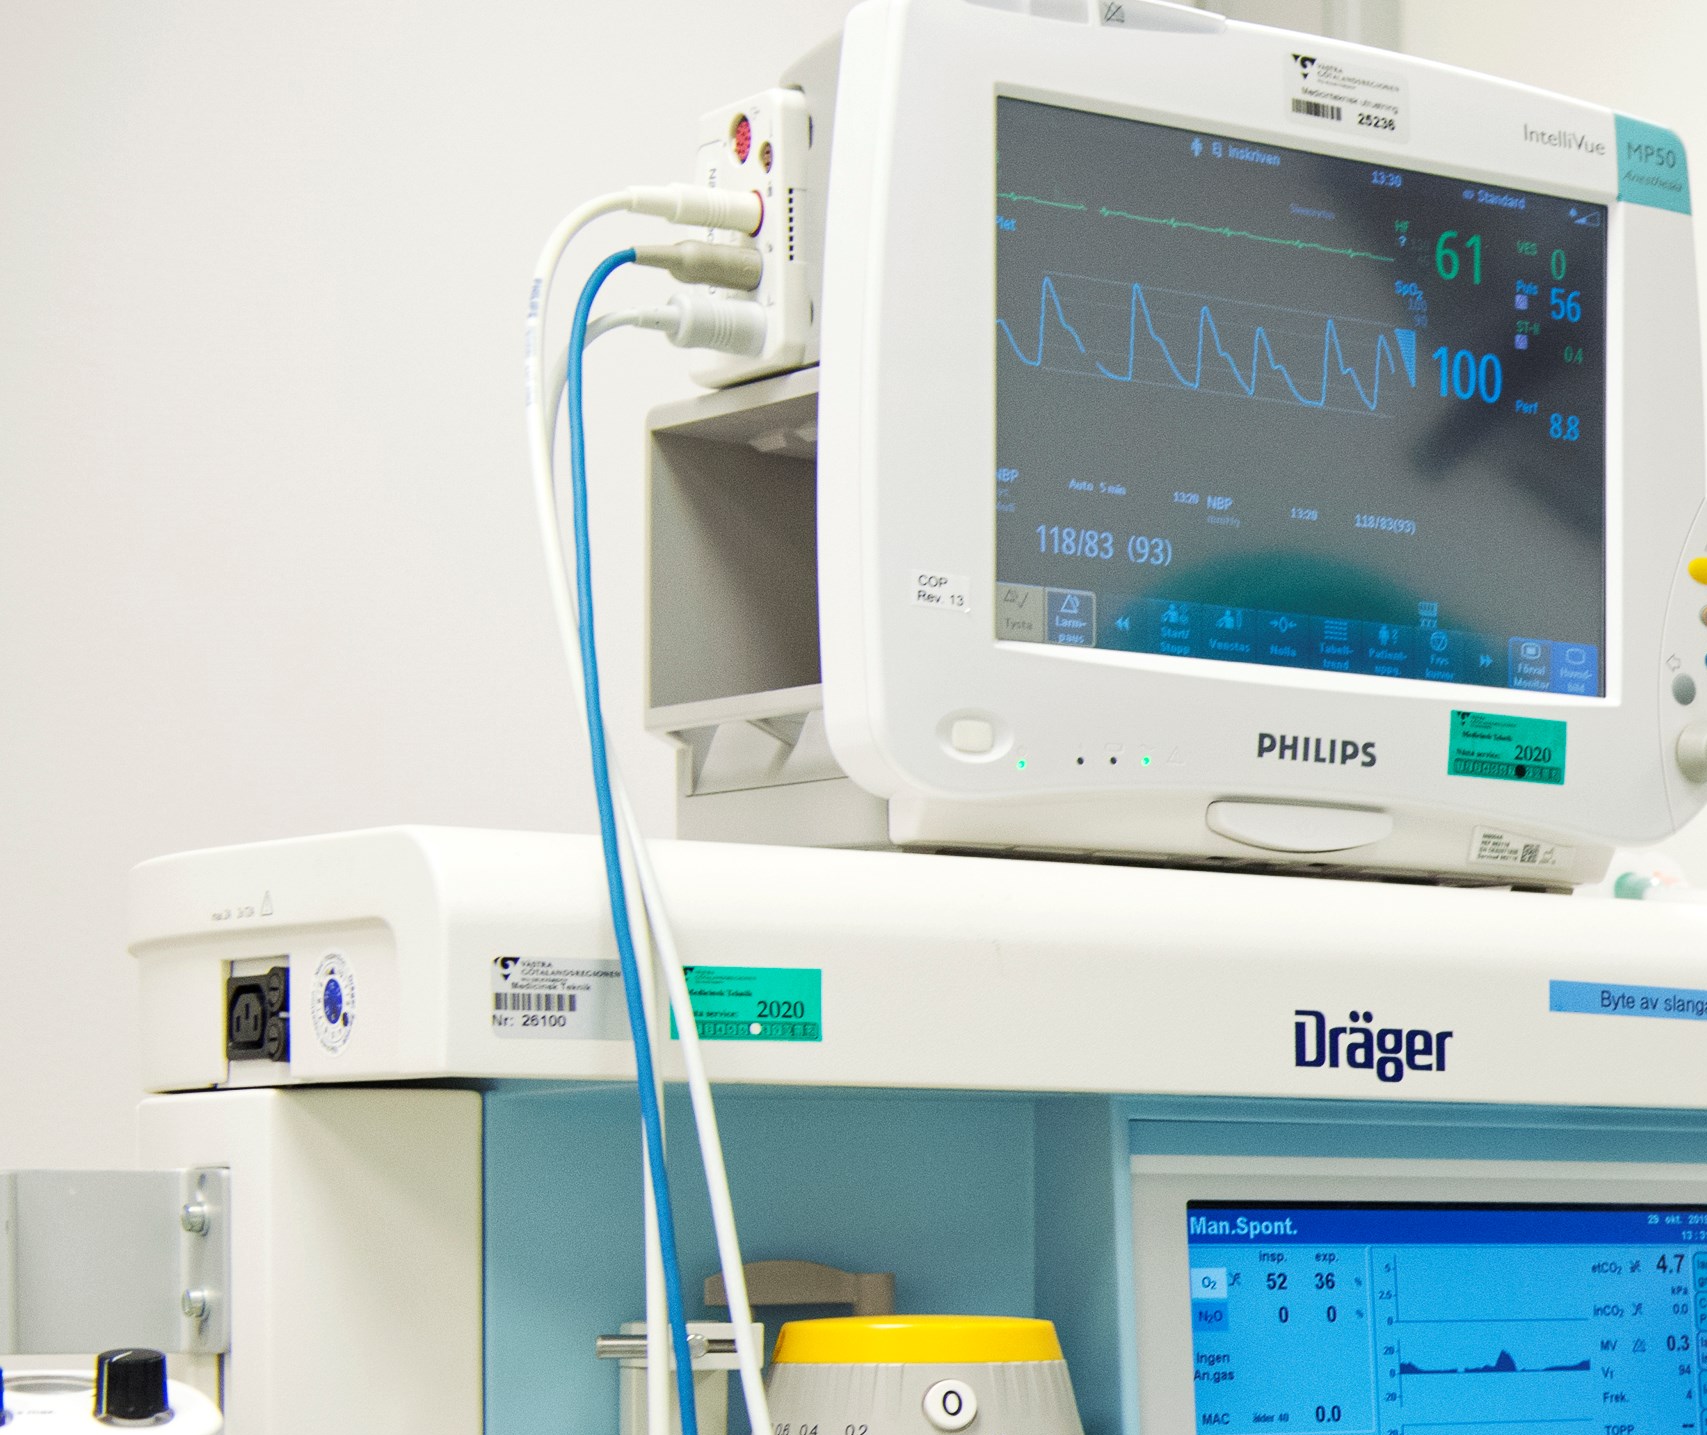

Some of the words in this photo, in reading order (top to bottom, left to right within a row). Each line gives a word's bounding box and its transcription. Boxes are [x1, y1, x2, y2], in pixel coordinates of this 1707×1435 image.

[1523, 124, 1606, 156] IntelliVue
[1626, 142, 1677, 168] MP50
[1435, 229, 1482, 286] 61
[1551, 249, 1567, 281] 0
[1550, 287, 1582, 323] 56
[1431, 345, 1503, 404] 100
[1549, 412, 1581, 441] 8.8
[1206, 496, 1233, 511] NBP
[1036, 524, 1114, 560] 118/83
[1127, 535, 1172, 567] (93)
[918, 574, 948, 588] COP
[1257, 732, 1377, 767] PHILIPS
[1514, 744, 1552, 763] 2020
[757, 1000, 804, 1018] 2020
[1600, 990, 1635, 1011] Byte
[1639, 997, 1658, 1010] av
[522, 1014, 567, 1027] 26100
[1295, 1010, 1453, 1082] Dräger
[1189, 1216, 1297, 1239] Man.Spont.
[1656, 1254, 1685, 1274] 4.7
[1266, 1273, 1288, 1290] 52
[1315, 1273, 1336, 1290] 36
[1279, 1306, 1289, 1323] 0
[1327, 1306, 1337, 1323] 0
[1667, 1335, 1690, 1351] 0.3
[1196, 1352, 1230, 1365] Ingen
[1202, 1413, 1230, 1425] MAC
[1315, 1405, 1341, 1422] 0.0
